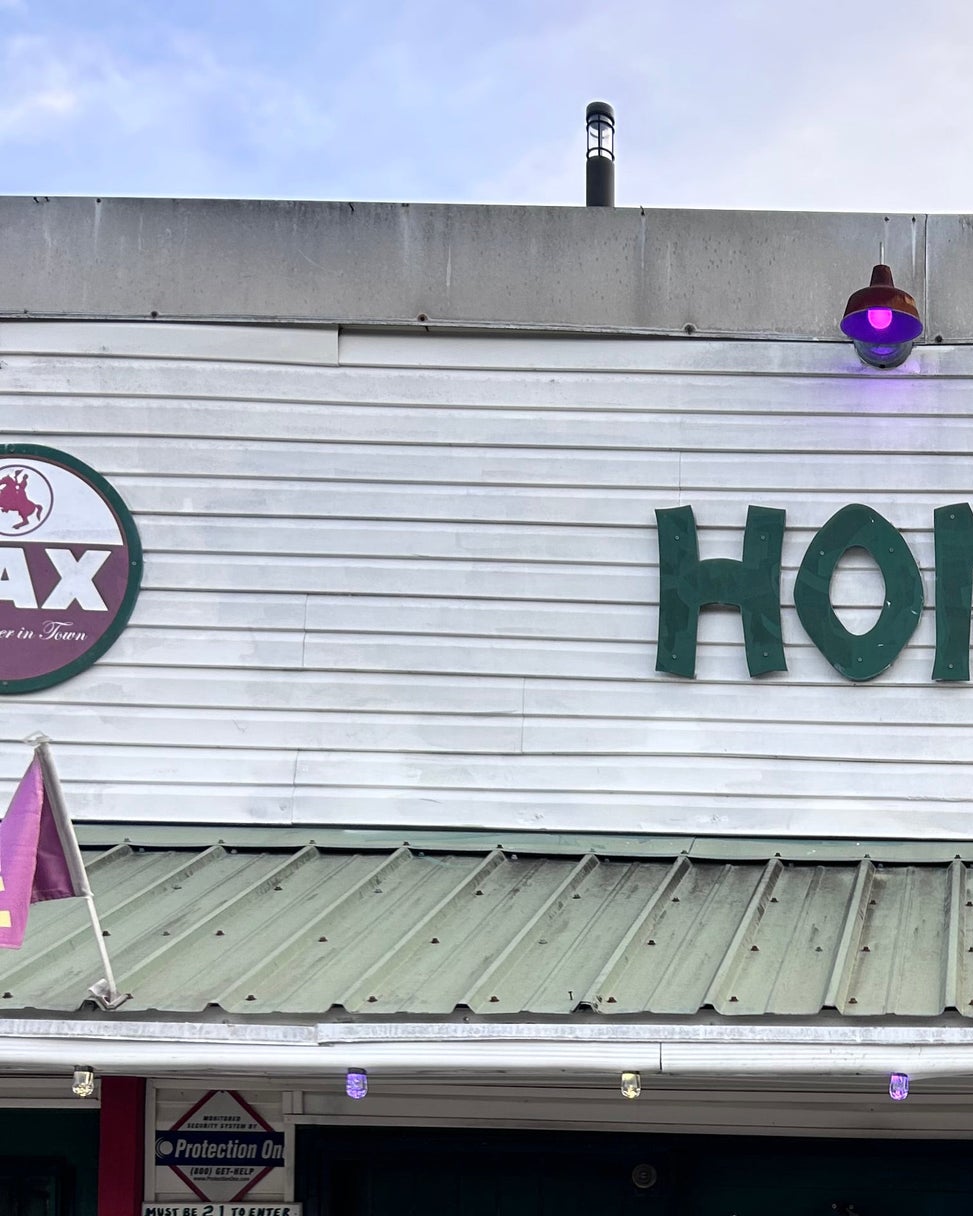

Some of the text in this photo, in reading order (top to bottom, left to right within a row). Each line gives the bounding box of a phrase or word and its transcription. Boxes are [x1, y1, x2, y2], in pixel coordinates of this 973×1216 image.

[17, 627, 34, 639] in
[39, 620, 88, 640] Town
[174, 1138, 258, 1159] Protection
[190, 1166, 255, 1177] (800) GET-HELP
[144, 1207, 179, 1216] MUST
[183, 1208, 197, 1216] BE
[231, 1208, 246, 1216] TO
